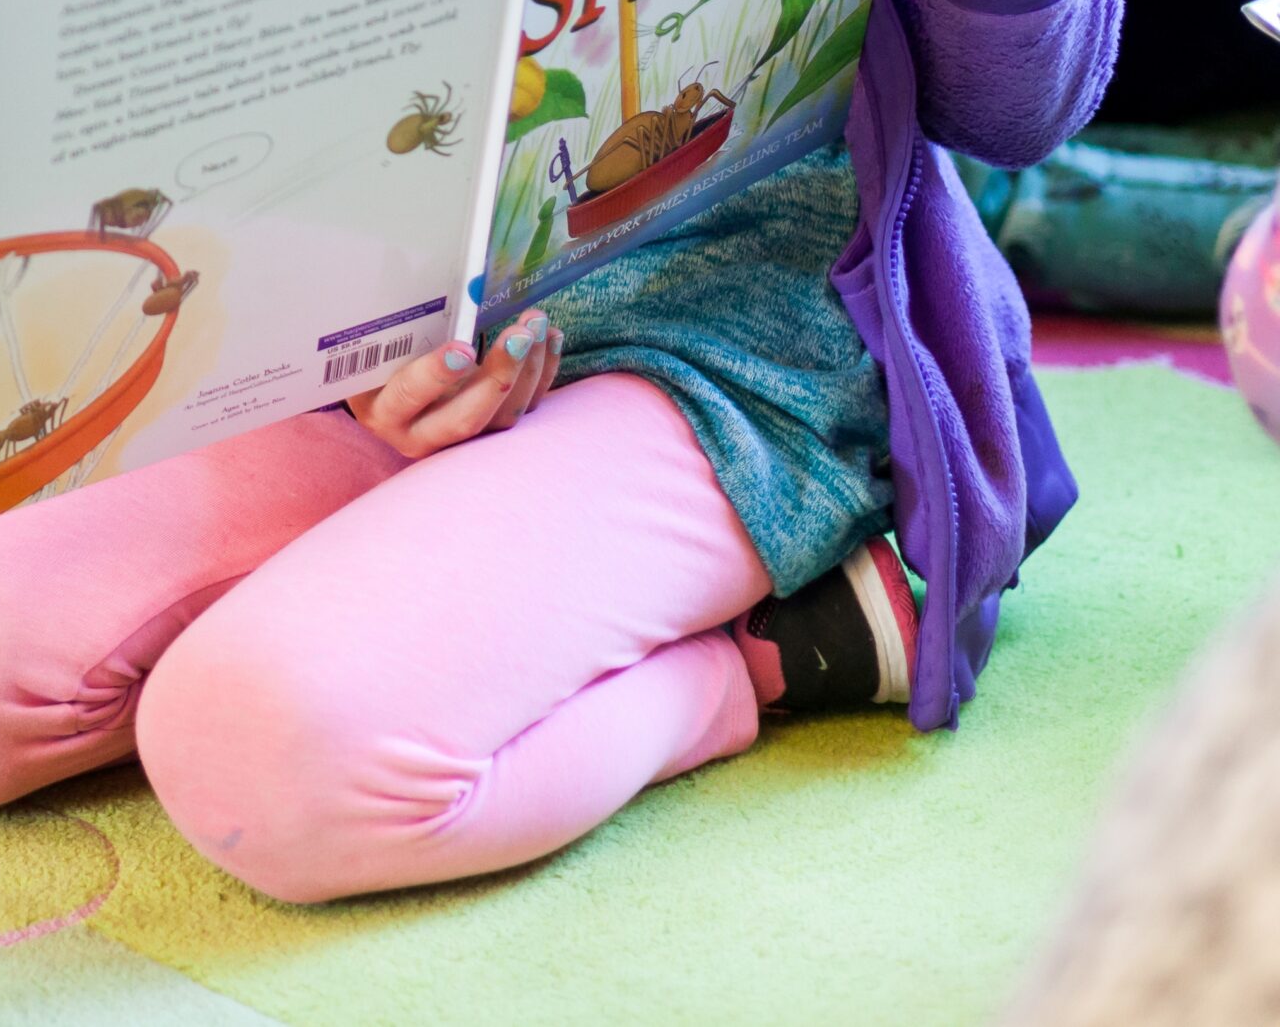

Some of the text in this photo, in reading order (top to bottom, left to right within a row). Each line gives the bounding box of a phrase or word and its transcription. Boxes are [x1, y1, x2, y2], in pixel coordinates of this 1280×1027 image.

[480, 289, 511, 313] ROM
[516, 269, 544, 293] THE
[549, 260, 563, 273] #1
[568, 235, 607, 265] NEW
[606, 217, 646, 243] YORK
[645, 190, 689, 221] TIMES
[693, 142, 782, 194] BESTSELLING
[785, 117, 824, 146] TEAM
[327, 346, 339, 354] US
[197, 363, 291, 399] Joanna Cotler Books
[222, 404, 239, 414] Ages
